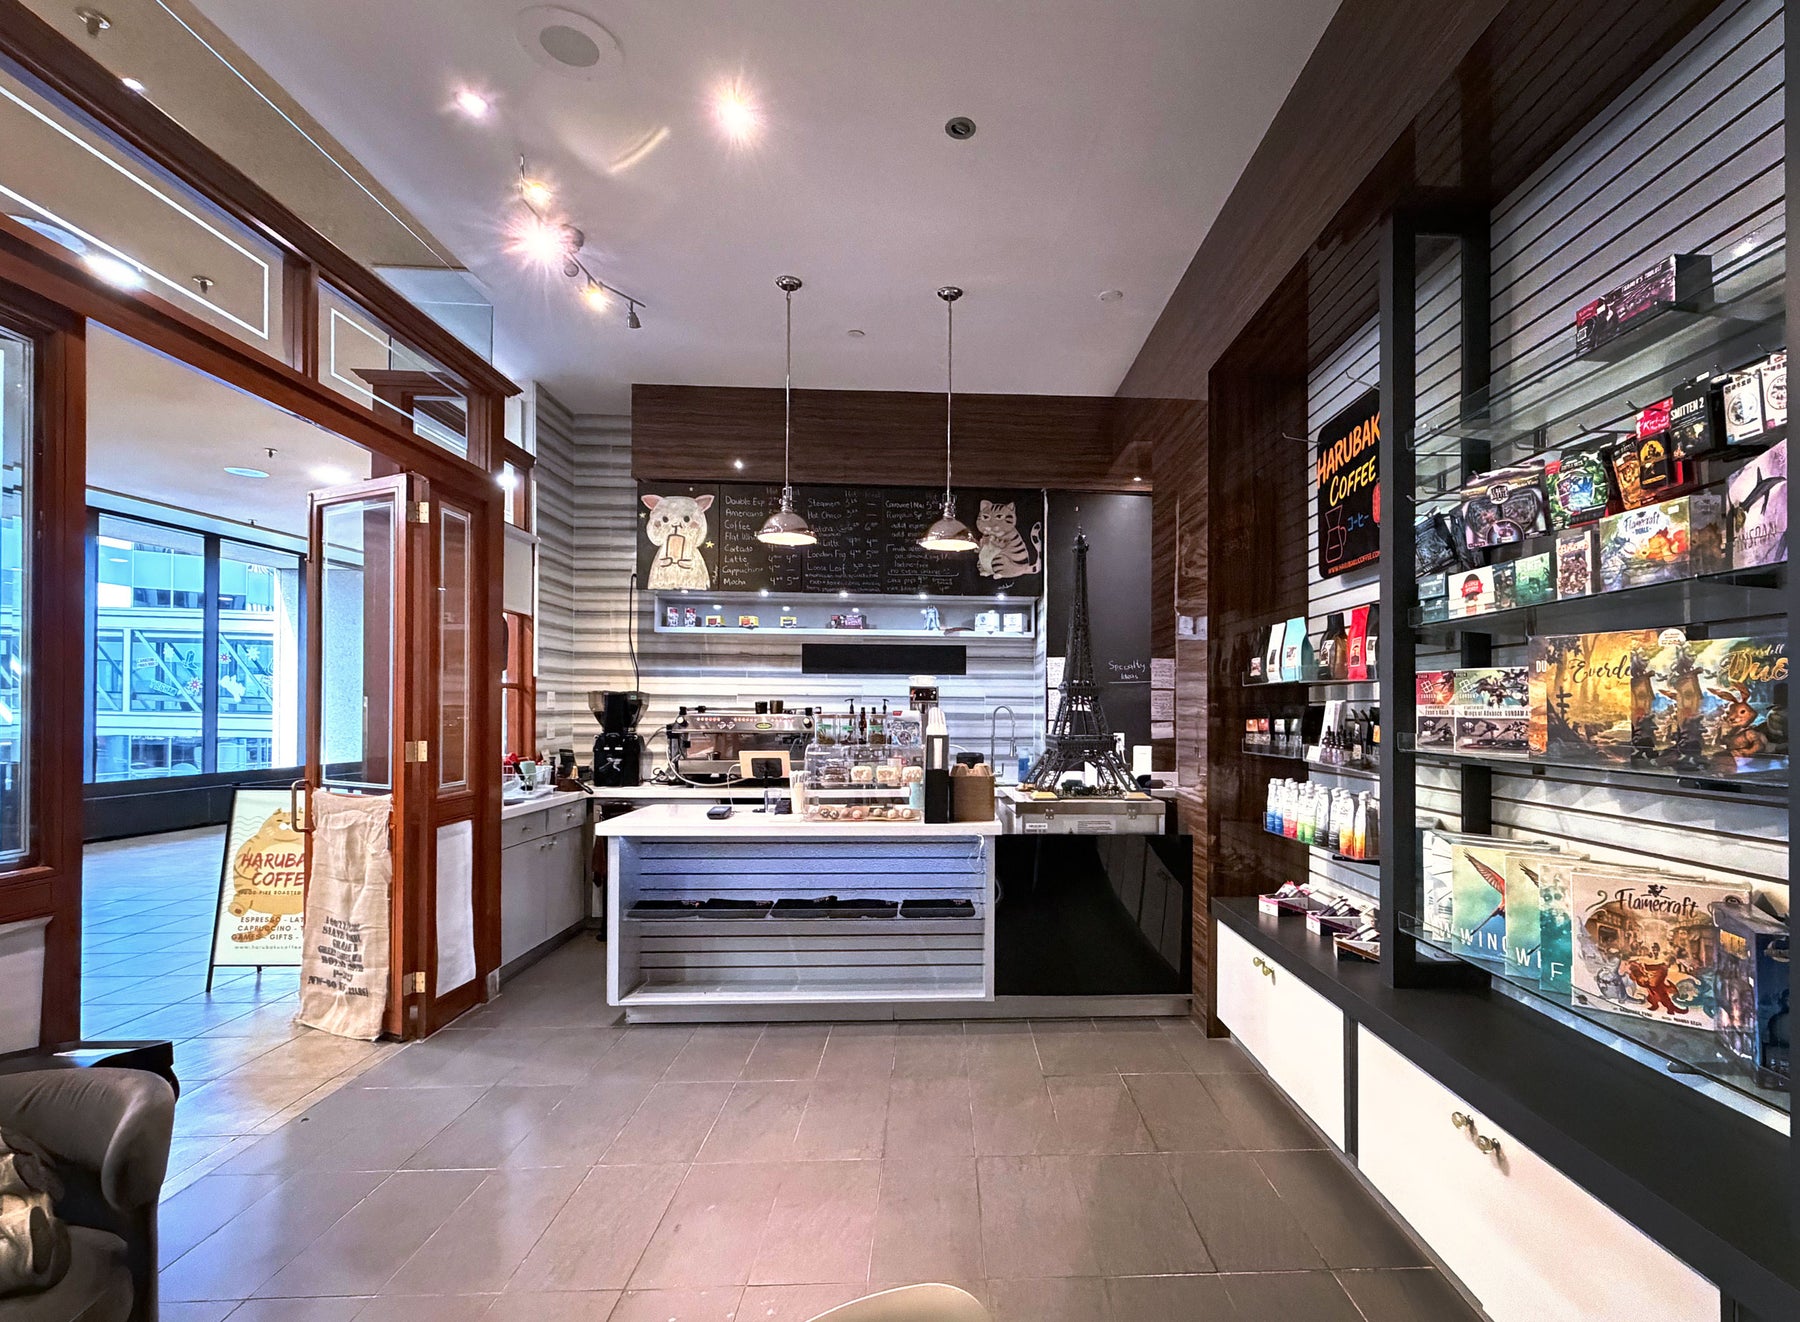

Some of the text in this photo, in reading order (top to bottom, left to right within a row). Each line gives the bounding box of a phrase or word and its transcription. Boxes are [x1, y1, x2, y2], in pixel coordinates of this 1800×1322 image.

[1670, 399, 1698, 420] SMITTEN
[1699, 397, 1704, 408] 2
[1329, 456, 1376, 506] COFFEE
[725, 495, 751, 505] Double
[725, 508, 763, 518] Americano
[807, 509, 819, 520] Hot
[821, 511, 842, 520] Choco
[724, 519, 751, 531] Coffee
[724, 555, 748, 564] Latte
[807, 549, 834, 559] London
[723, 578, 746, 586] Mocha
[1535, 660, 1547, 673] DU
[240, 853, 305, 870] HARUBA
[252, 872, 305, 887] COFFE
[1614, 887, 1699, 918] Flamecraft
